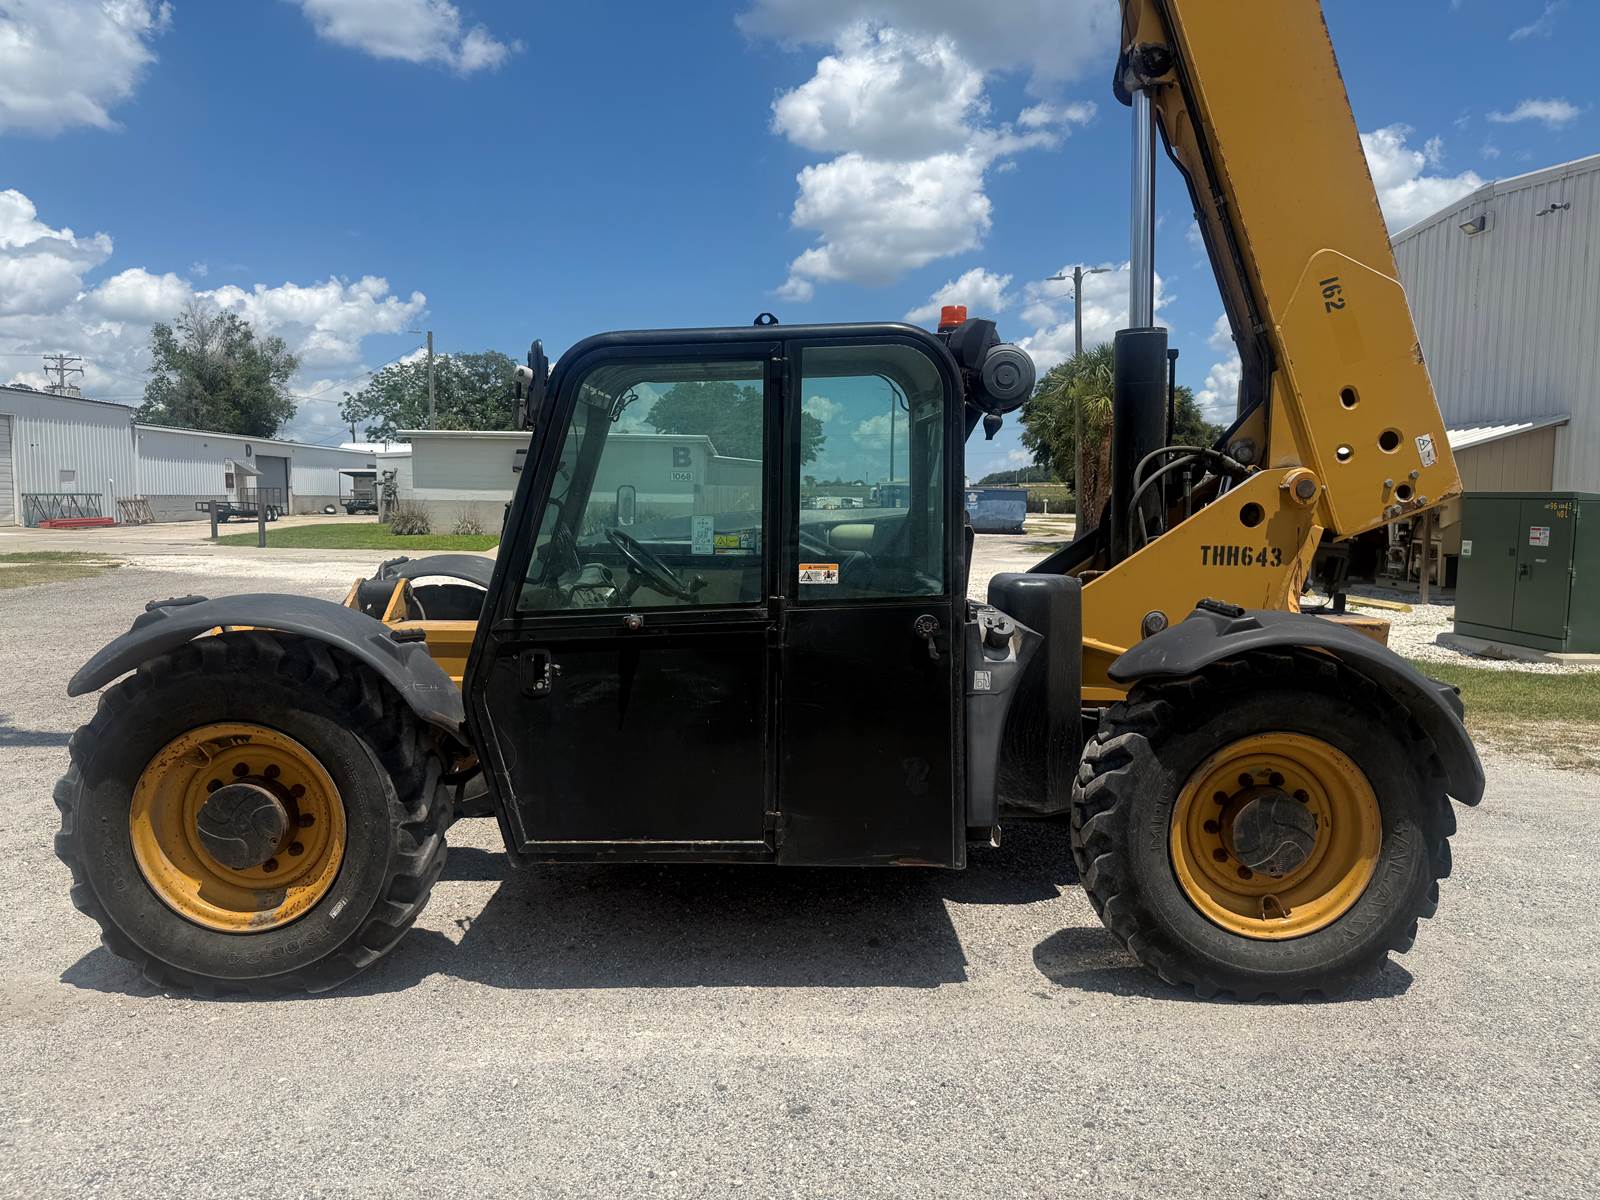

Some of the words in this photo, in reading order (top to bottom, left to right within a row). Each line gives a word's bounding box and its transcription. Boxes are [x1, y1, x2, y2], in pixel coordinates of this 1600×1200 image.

[1319, 276, 1346, 313] 162
[245, 444, 252, 457] D
[672, 446, 692, 467] B
[1200, 545, 1282, 568] THH643
